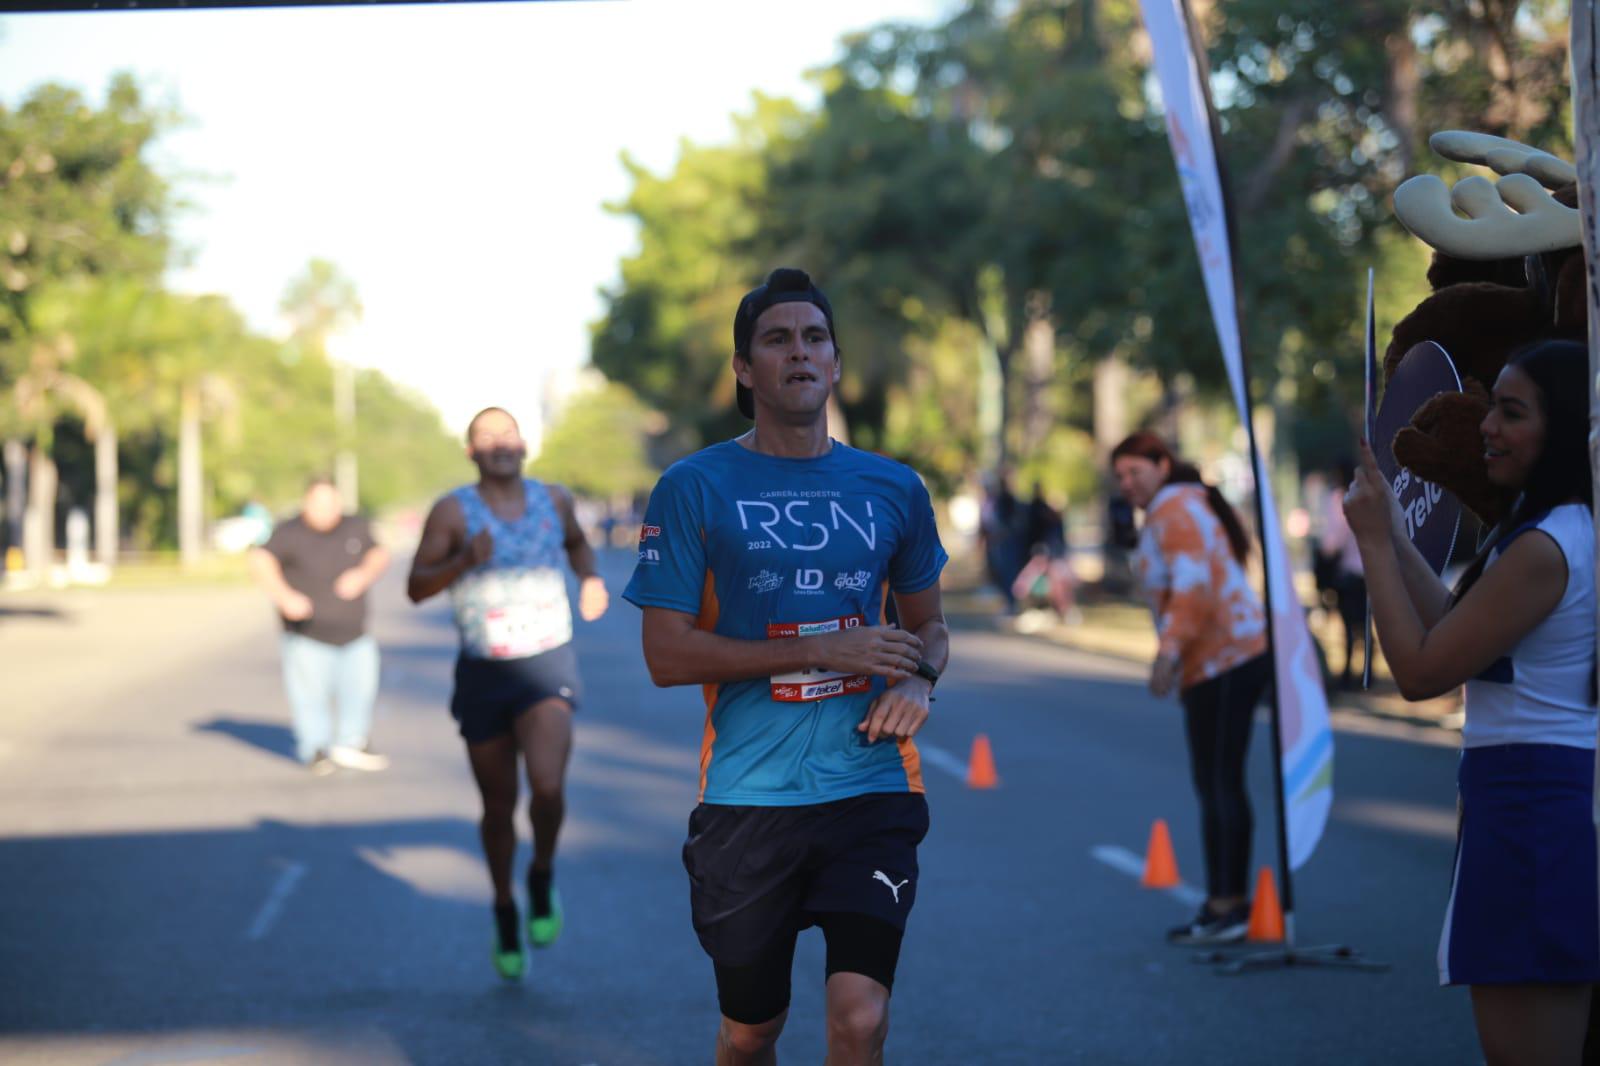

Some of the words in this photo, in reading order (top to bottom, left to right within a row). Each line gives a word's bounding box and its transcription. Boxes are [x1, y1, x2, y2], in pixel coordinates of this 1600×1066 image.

[1393, 467, 1410, 498] es
[759, 490, 799, 498] CARRERA
[800, 490, 841, 498] PEDESTRE
[736, 500, 876, 551] RSN
[747, 540, 772, 550] 2022
[815, 682, 842, 696] telcel
